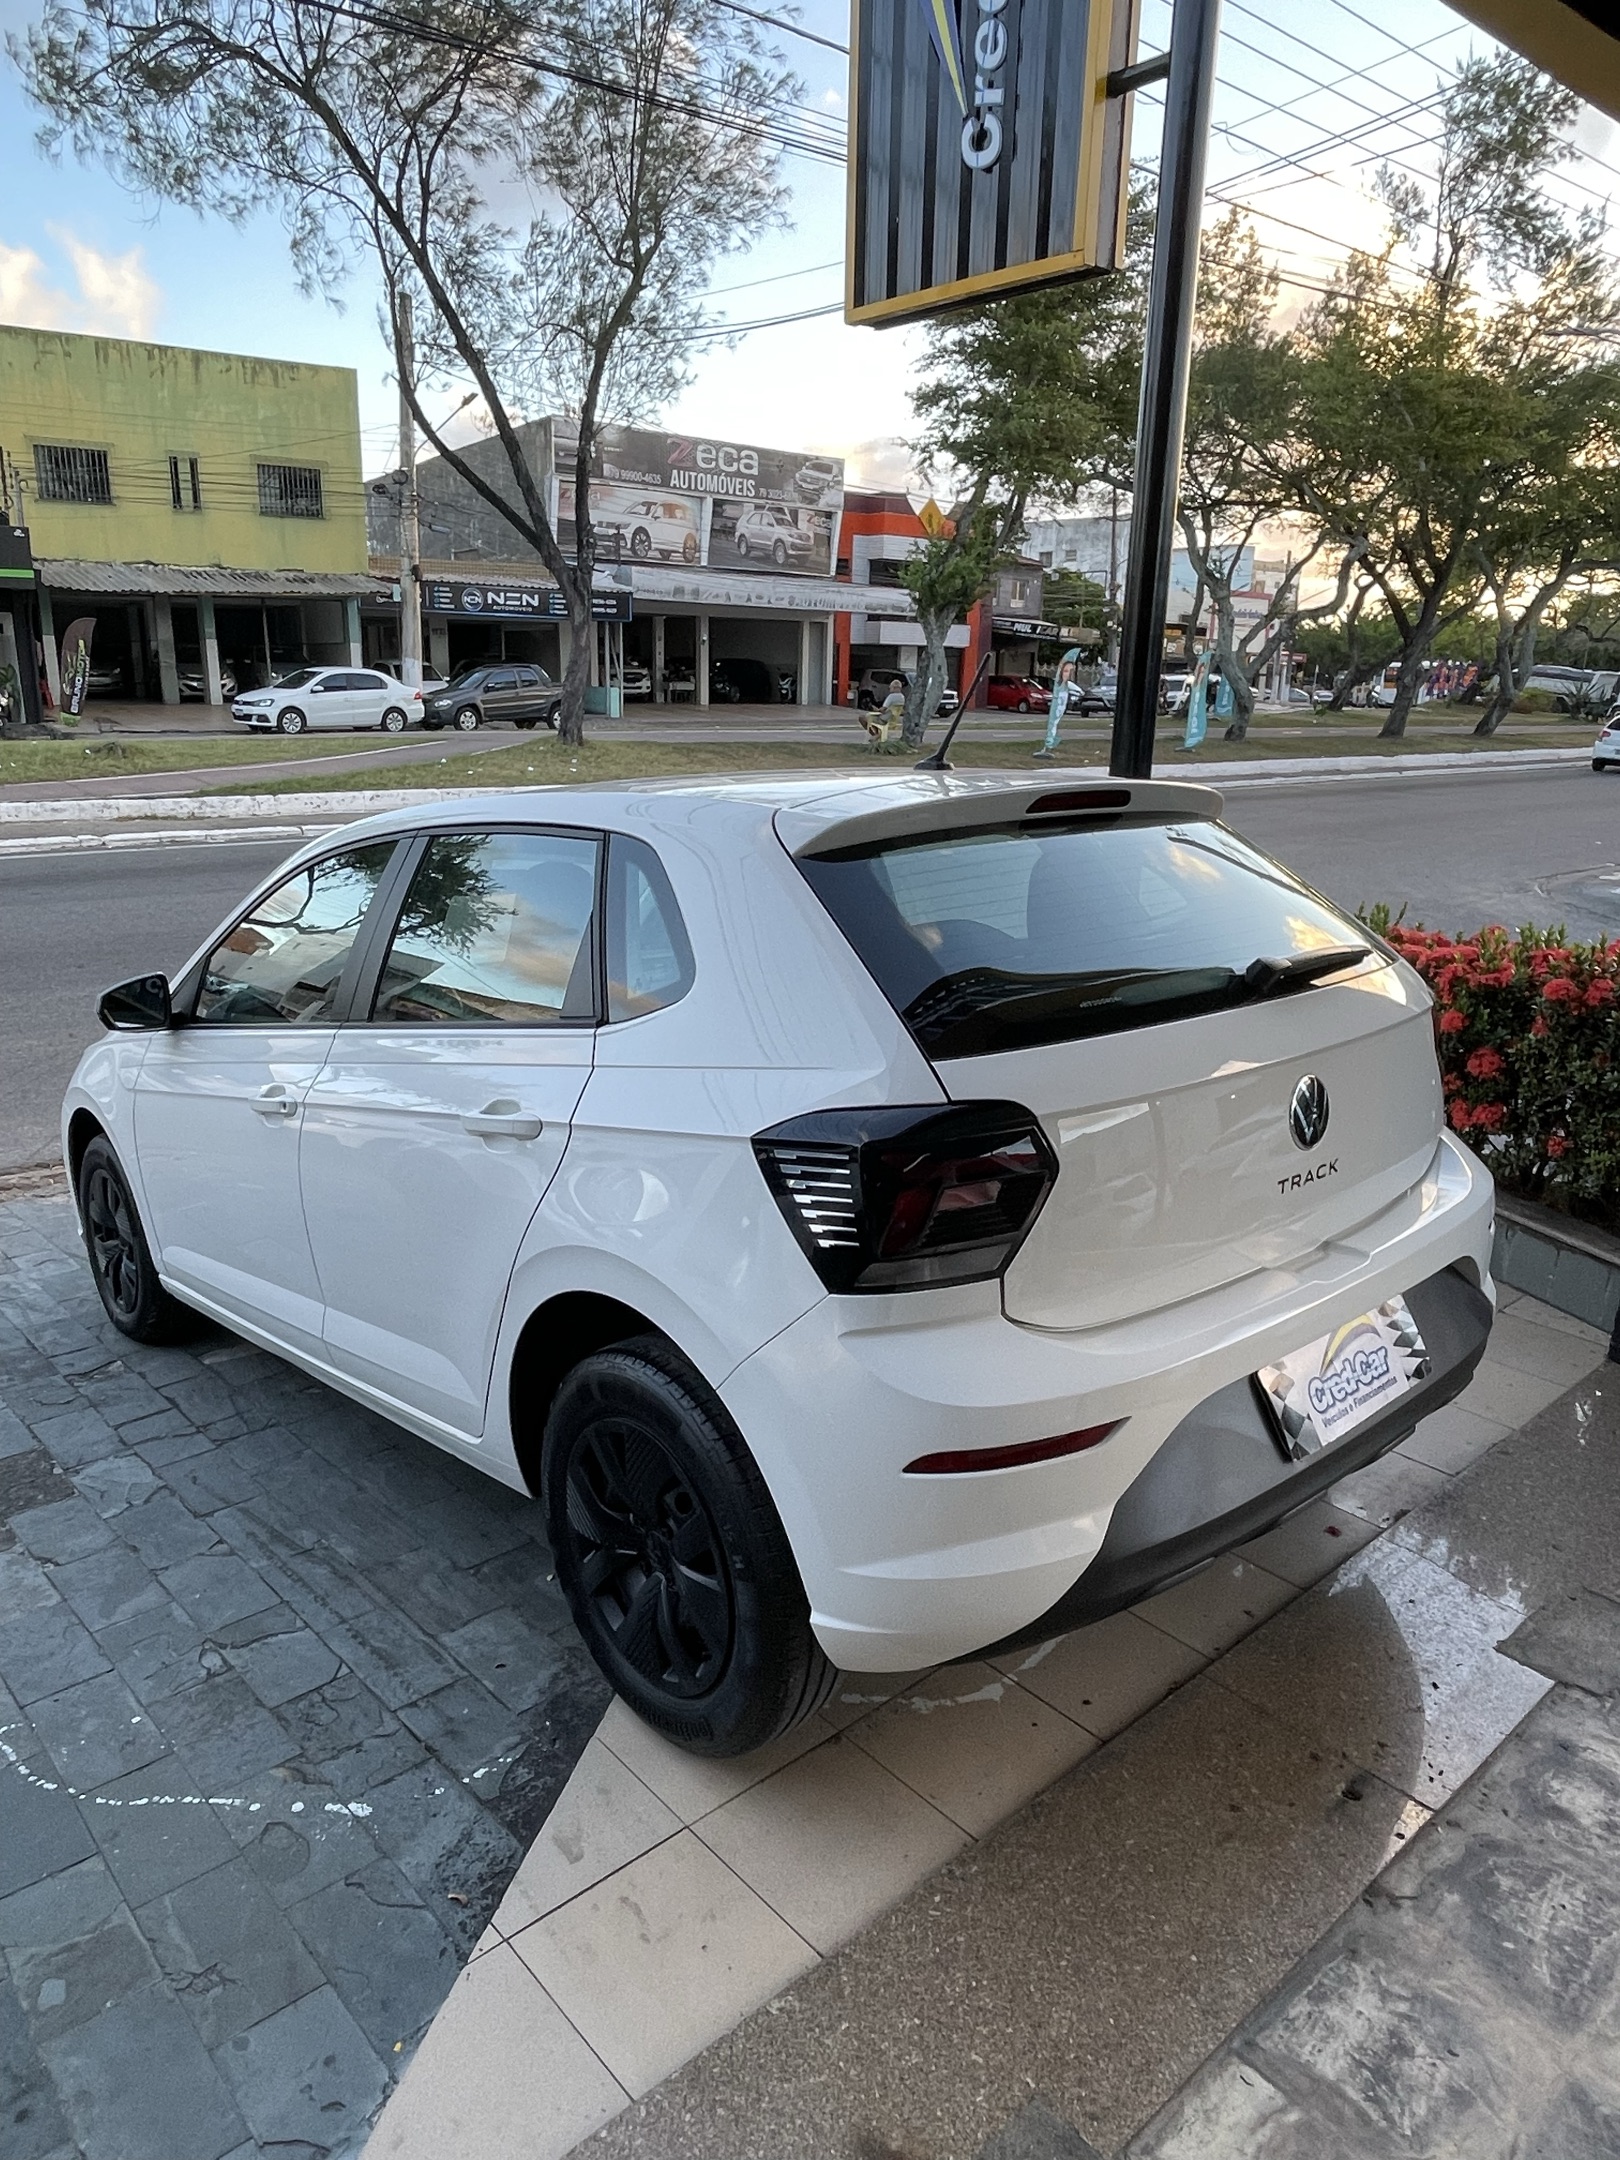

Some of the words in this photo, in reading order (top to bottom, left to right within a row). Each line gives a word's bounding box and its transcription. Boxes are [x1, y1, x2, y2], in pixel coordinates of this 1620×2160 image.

[962, 0, 1008, 169] Cre
[666, 437, 759, 476] Zeca
[670, 469, 756, 497] AUTOMÓVEIS
[487, 592, 539, 606] NEN
[1277, 1158, 1339, 1194] TRACK
